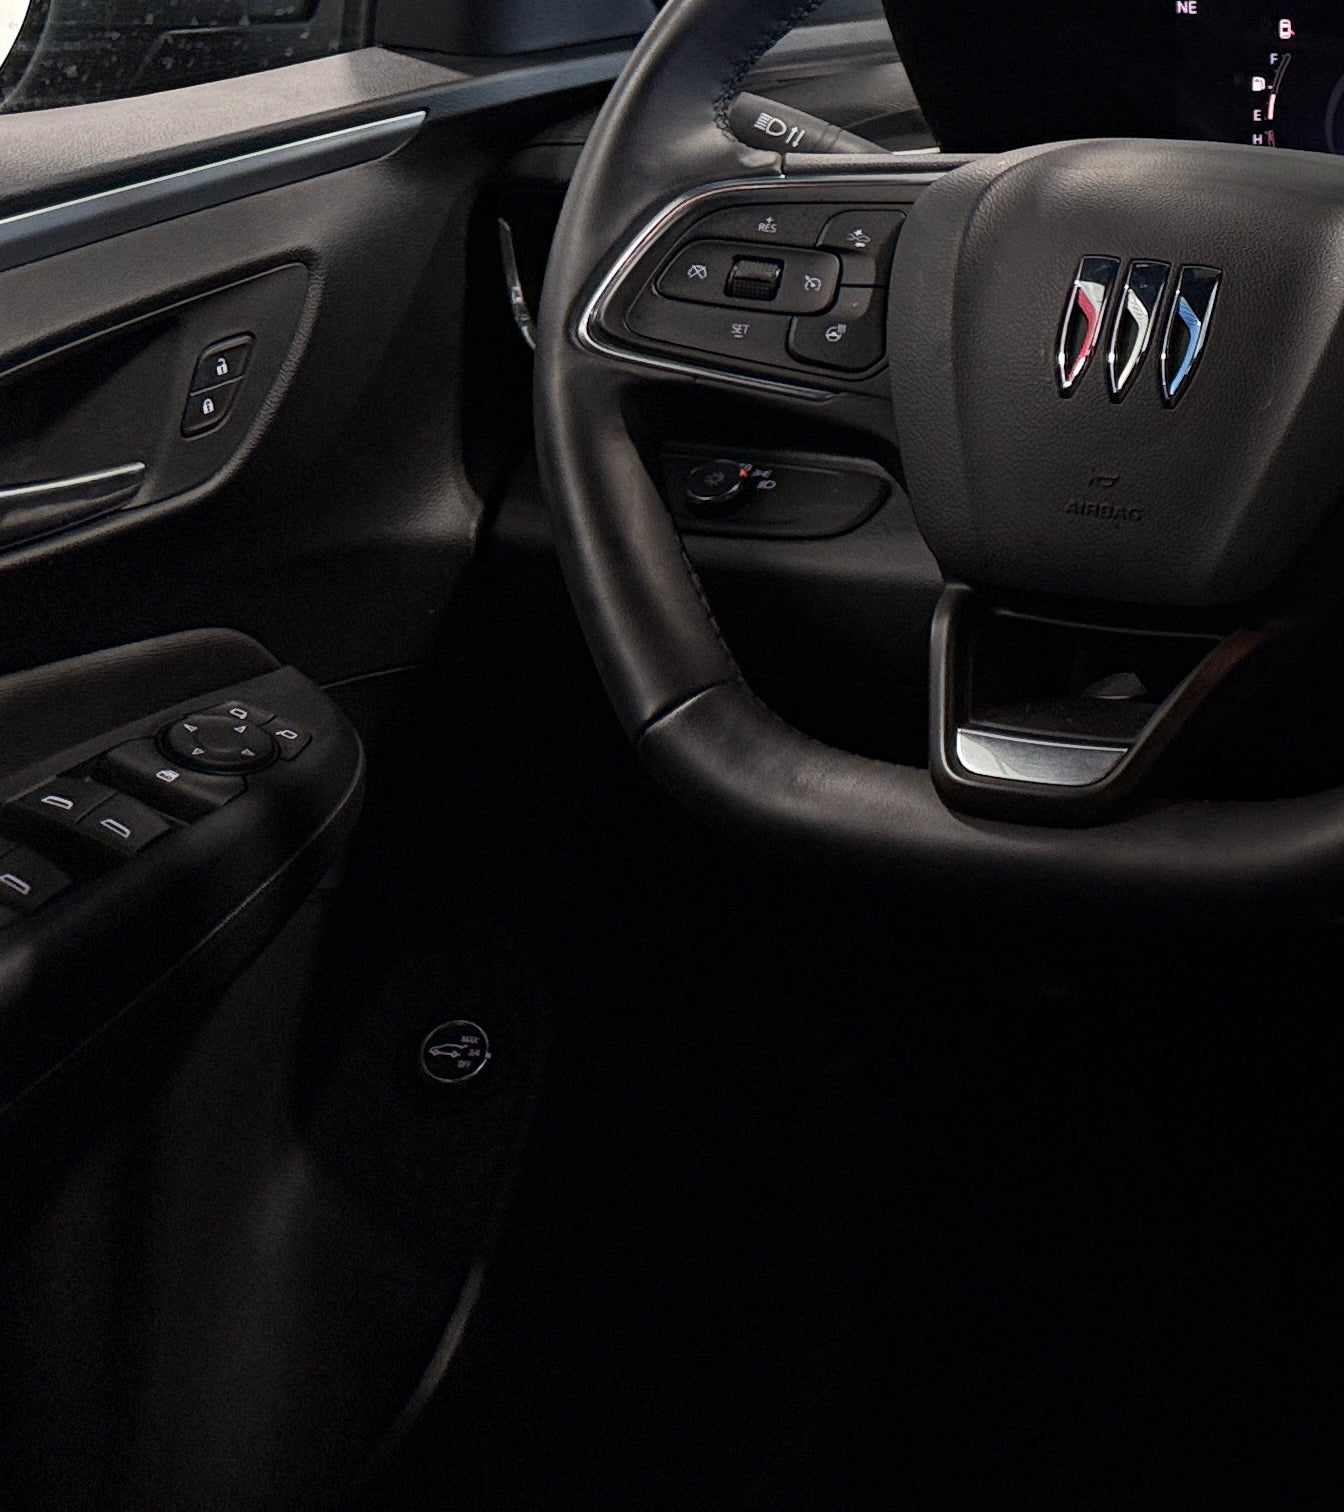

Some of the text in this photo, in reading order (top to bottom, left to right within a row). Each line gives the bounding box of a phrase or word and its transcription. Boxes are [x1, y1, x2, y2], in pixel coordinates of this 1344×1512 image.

[1175, 0, 1198, 15] NE
[1269, 53, 1279, 65] F
[1253, 110, 1263, 121] E
[1253, 134, 1263, 145] H
[758, 223, 778, 234] RES
[731, 324, 750, 336] SET
